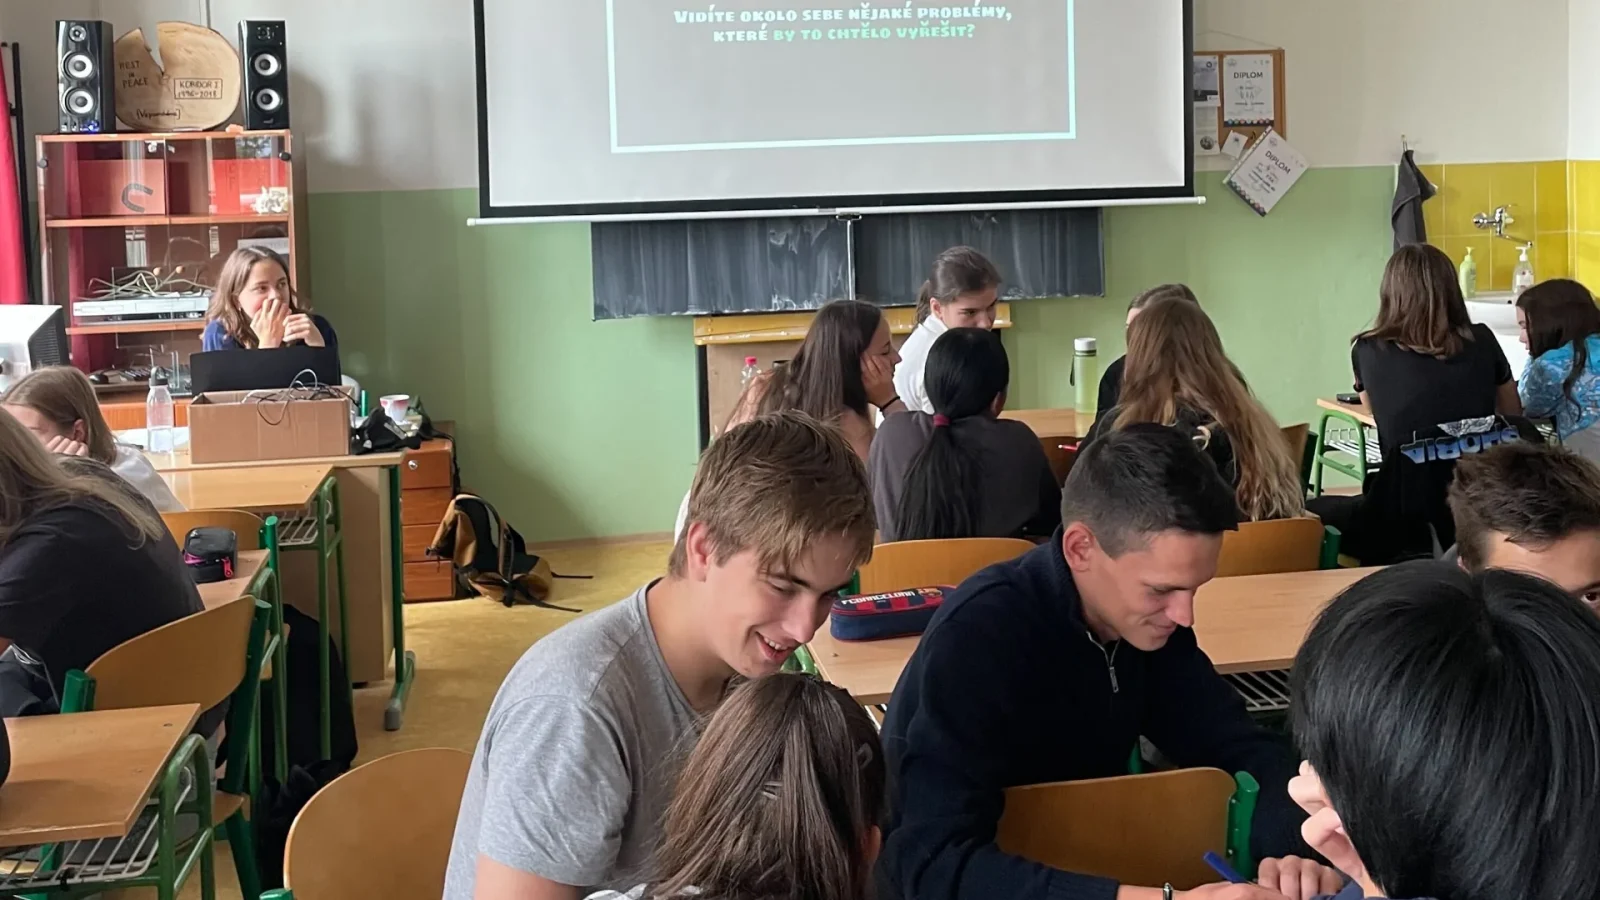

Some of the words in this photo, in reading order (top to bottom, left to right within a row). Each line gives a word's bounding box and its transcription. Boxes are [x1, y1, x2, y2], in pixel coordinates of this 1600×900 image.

[740, 9, 798, 22] OKOLO
[802, 9, 844, 21] SEBE
[848, 1, 912, 21] NĚJAKÉ
[917, 0, 1013, 21] PROBLÉMY,
[713, 23, 768, 42] KTERÉ
[773, 30, 796, 42] BY
[801, 29, 823, 40] TO
[828, 21, 891, 40] CHTĚLO
[896, 20, 975, 40] VYŘEŠIT?
[119, 60, 140, 70] REST
[122, 77, 149, 89] PEACE
[1233, 71, 1264, 79] DIPLOM
[1265, 150, 1291, 174] DIPLOM
